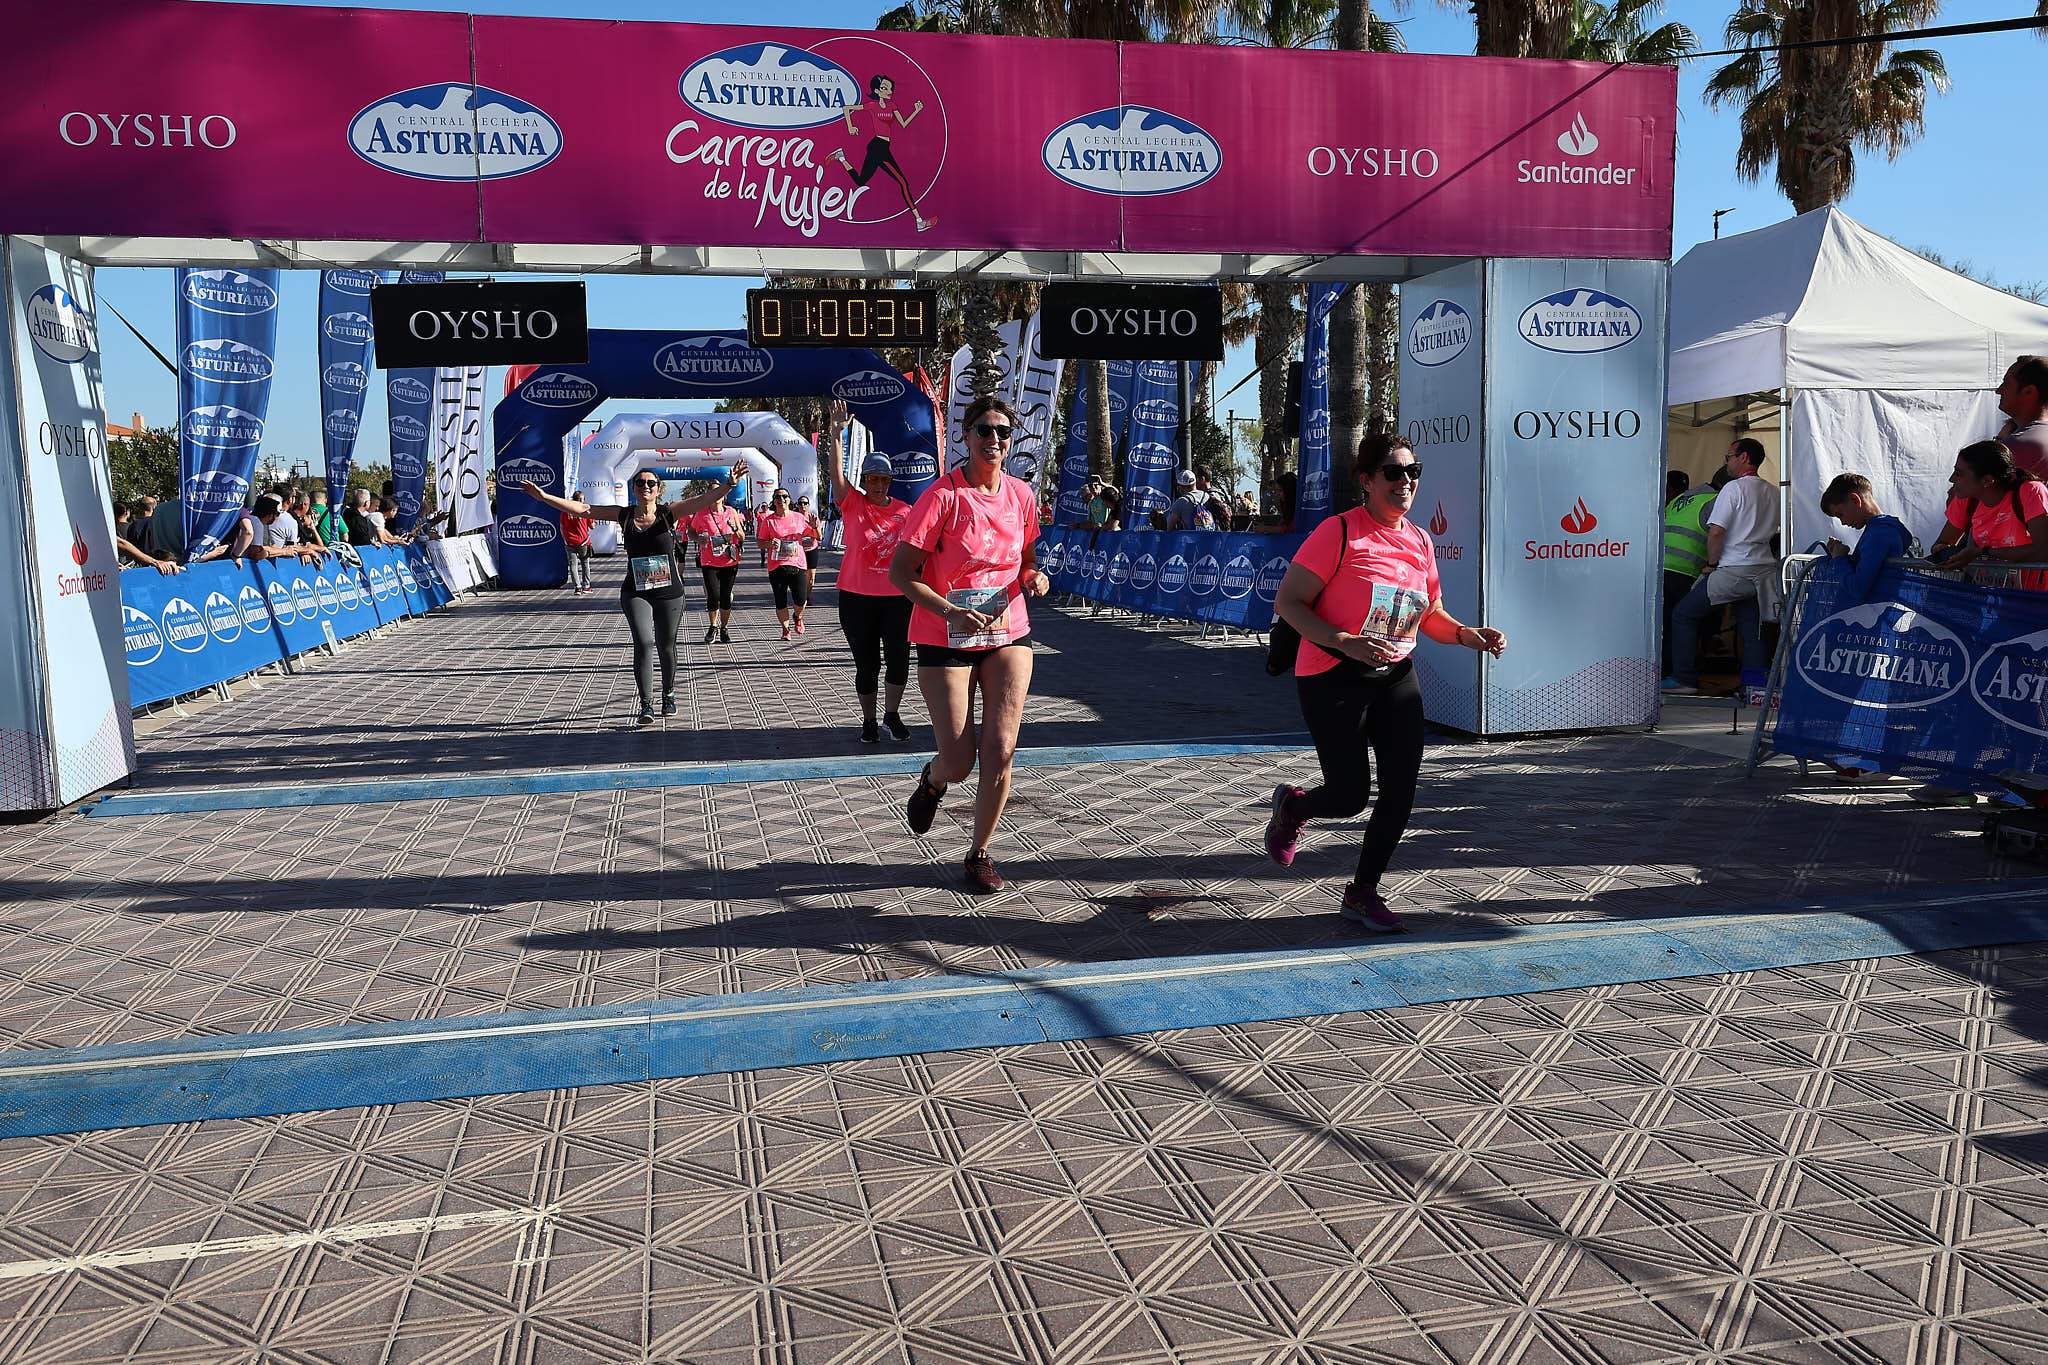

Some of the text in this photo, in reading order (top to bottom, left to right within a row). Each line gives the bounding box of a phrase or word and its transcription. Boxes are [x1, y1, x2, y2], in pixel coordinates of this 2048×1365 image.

[722, 71, 841, 83] CENTRAL LECHERA
[694, 72, 846, 108] ASTURIANA
[60, 111, 237, 149] OYSHO
[397, 115, 465, 126] CENTRAL
[366, 117, 547, 156] ASTURIANA
[665, 119, 815, 168] Carrera
[1084, 135, 1204, 147] CENTRAL LECHERA
[1057, 136, 1208, 173] ASTURIANA
[1307, 146, 1439, 178] OYSHO
[1517, 159, 1636, 186] Santander
[704, 165, 870, 238] de la Mujer
[186, 280, 270, 307] ASTURIANA
[34, 306, 88, 348] ASTURIANA
[409, 310, 558, 340] OYSHO
[761, 299, 923, 337] 01:00:34
[1070, 307, 1197, 337] OYSHO
[1527, 312, 1633, 337] ASTURIANA
[1412, 327, 1466, 353] ASTURIANA
[187, 350, 268, 376] ASTURIANA
[663, 351, 765, 373] ASTURIANA
[1106, 362, 1132, 375] URIANA
[1142, 363, 1178, 379] ASTURIA
[526, 385, 591, 399] ASTURIANA
[838, 384, 901, 397] ASTURIANA
[186, 418, 260, 440] ASTURIANA
[650, 419, 745, 440] OYSHO
[1408, 414, 1470, 447] OYSHO
[1513, 409, 1641, 440] OYSHO
[39, 421, 100, 459] OYSHO
[440, 377, 462, 499] OYSH
[593, 442, 623, 450] OYSHO
[1132, 452, 1173, 466] ASTURIANA
[500, 470, 551, 482] ASTURIANA
[583, 480, 610, 488] OYSHO
[501, 527, 553, 539] ASTURIANA
[1434, 540, 1464, 561] ander
[1525, 539, 1629, 560] Santander
[58, 571, 106, 597] Santander
[166, 620, 207, 642] ASTURIANA
[208, 612, 241, 632] ASTURIANA
[1837, 632, 1952, 657] CENTRAL LECHERA
[1804, 633, 1950, 689] ASTURIANA
